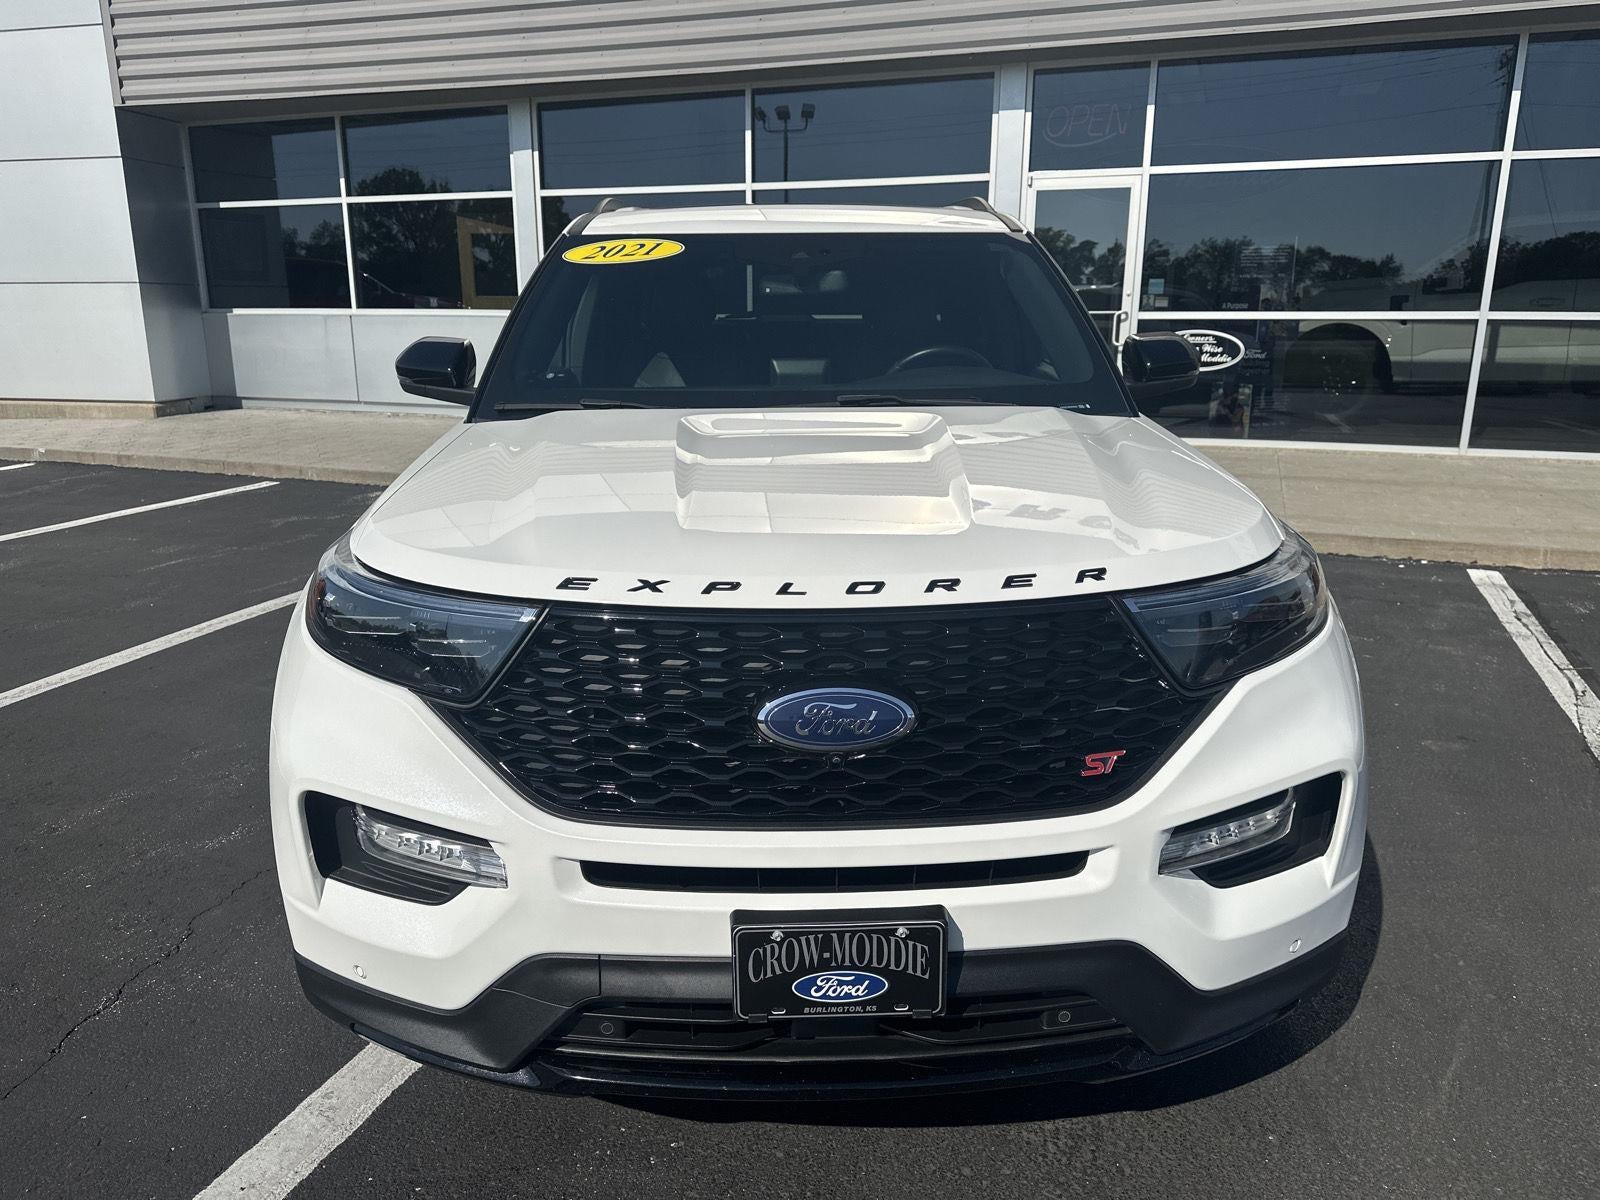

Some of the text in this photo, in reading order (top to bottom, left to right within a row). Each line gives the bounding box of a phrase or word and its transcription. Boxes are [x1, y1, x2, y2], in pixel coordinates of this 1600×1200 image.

[1046, 103, 1132, 138] OPEN
[580, 242, 664, 261] 2021
[555, 566, 1108, 596] EXPLORER
[795, 701, 879, 737] Ford
[1081, 750, 1127, 777] ST
[748, 932, 931, 984] CROW-MODDIE
[810, 975, 870, 998] Ford
[803, 1004, 877, 1014] BURLINGTON, KS
